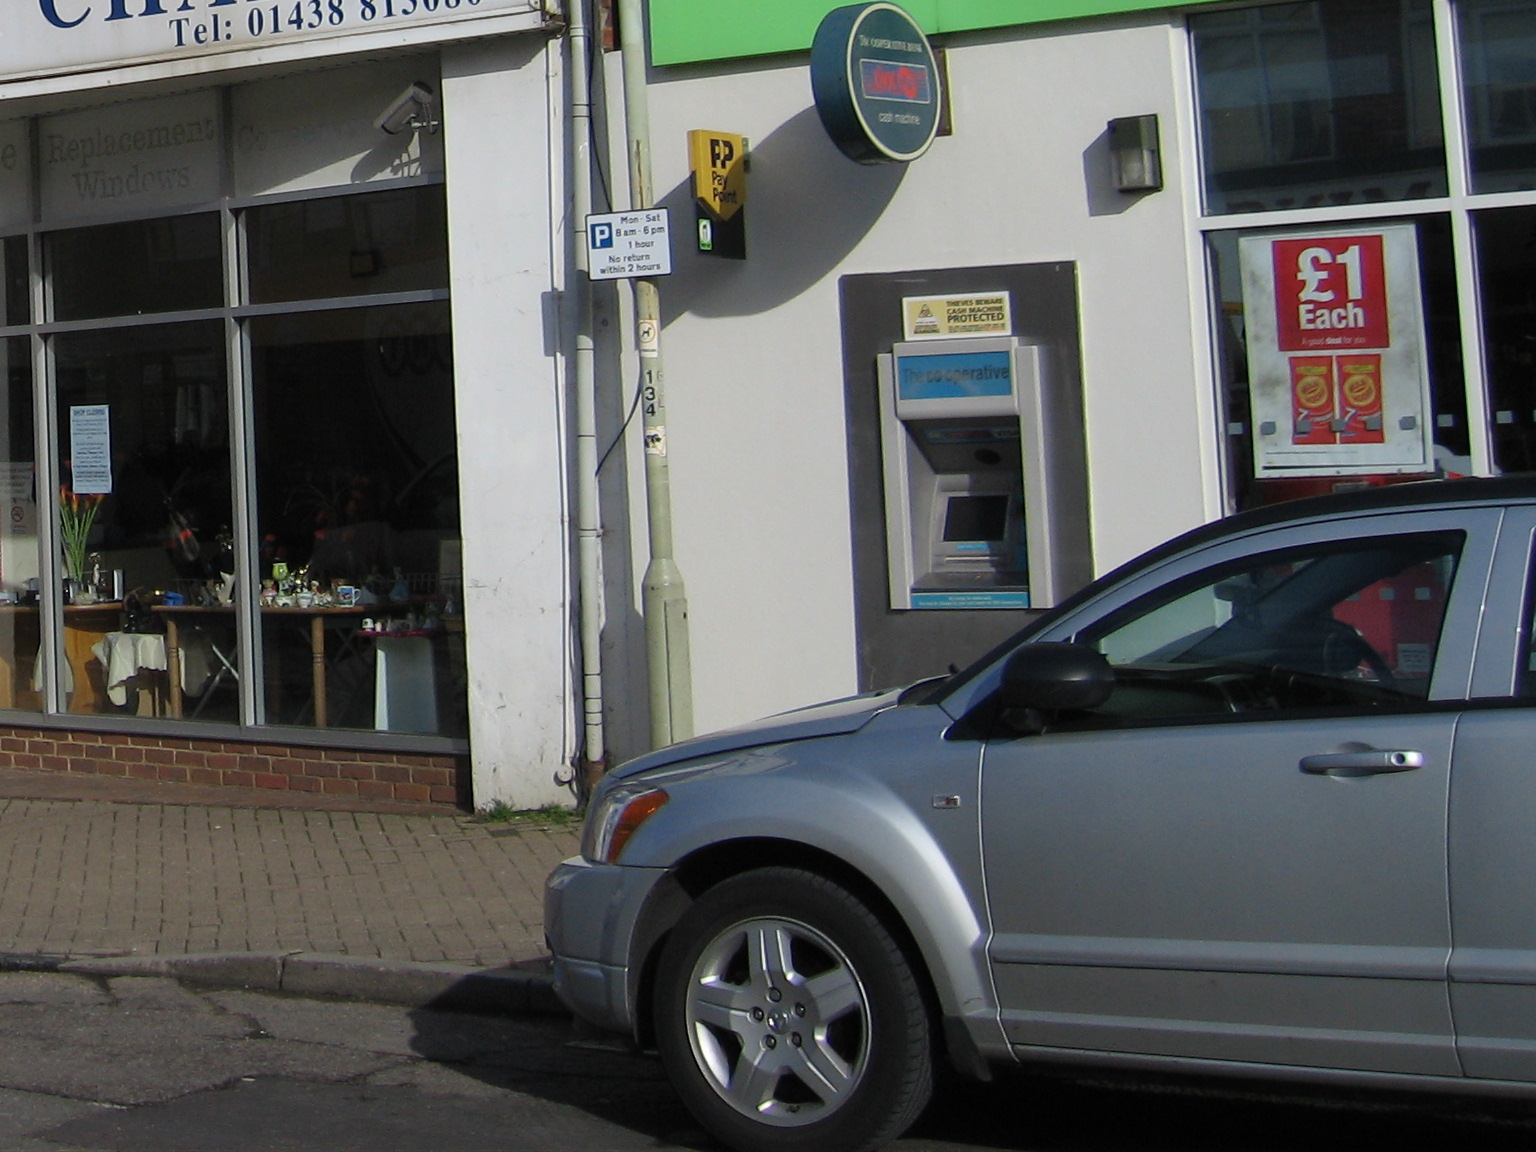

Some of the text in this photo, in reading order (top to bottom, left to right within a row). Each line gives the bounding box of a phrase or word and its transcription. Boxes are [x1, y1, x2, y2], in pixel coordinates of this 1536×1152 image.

[169, 18, 232, 48] Tel:
[878, 112, 921, 126] cash machine
[46, 118, 216, 167] Replacement
[73, 164, 190, 202] Windows
[711, 171, 728, 189] Pay
[713, 187, 738, 204] Point
[645, 214, 661, 222] Sat
[595, 225, 610, 248] P
[635, 240, 655, 248] hour
[609, 253, 650, 263] No return
[600, 263, 661, 274] within 2 hours
[1297, 244, 1363, 303] £1
[946, 297, 1003, 307] THIEVES BEWARE
[969, 305, 1003, 313] MACHINE
[947, 313, 1005, 324] PROTECTED
[1298, 302, 1365, 330] Each
